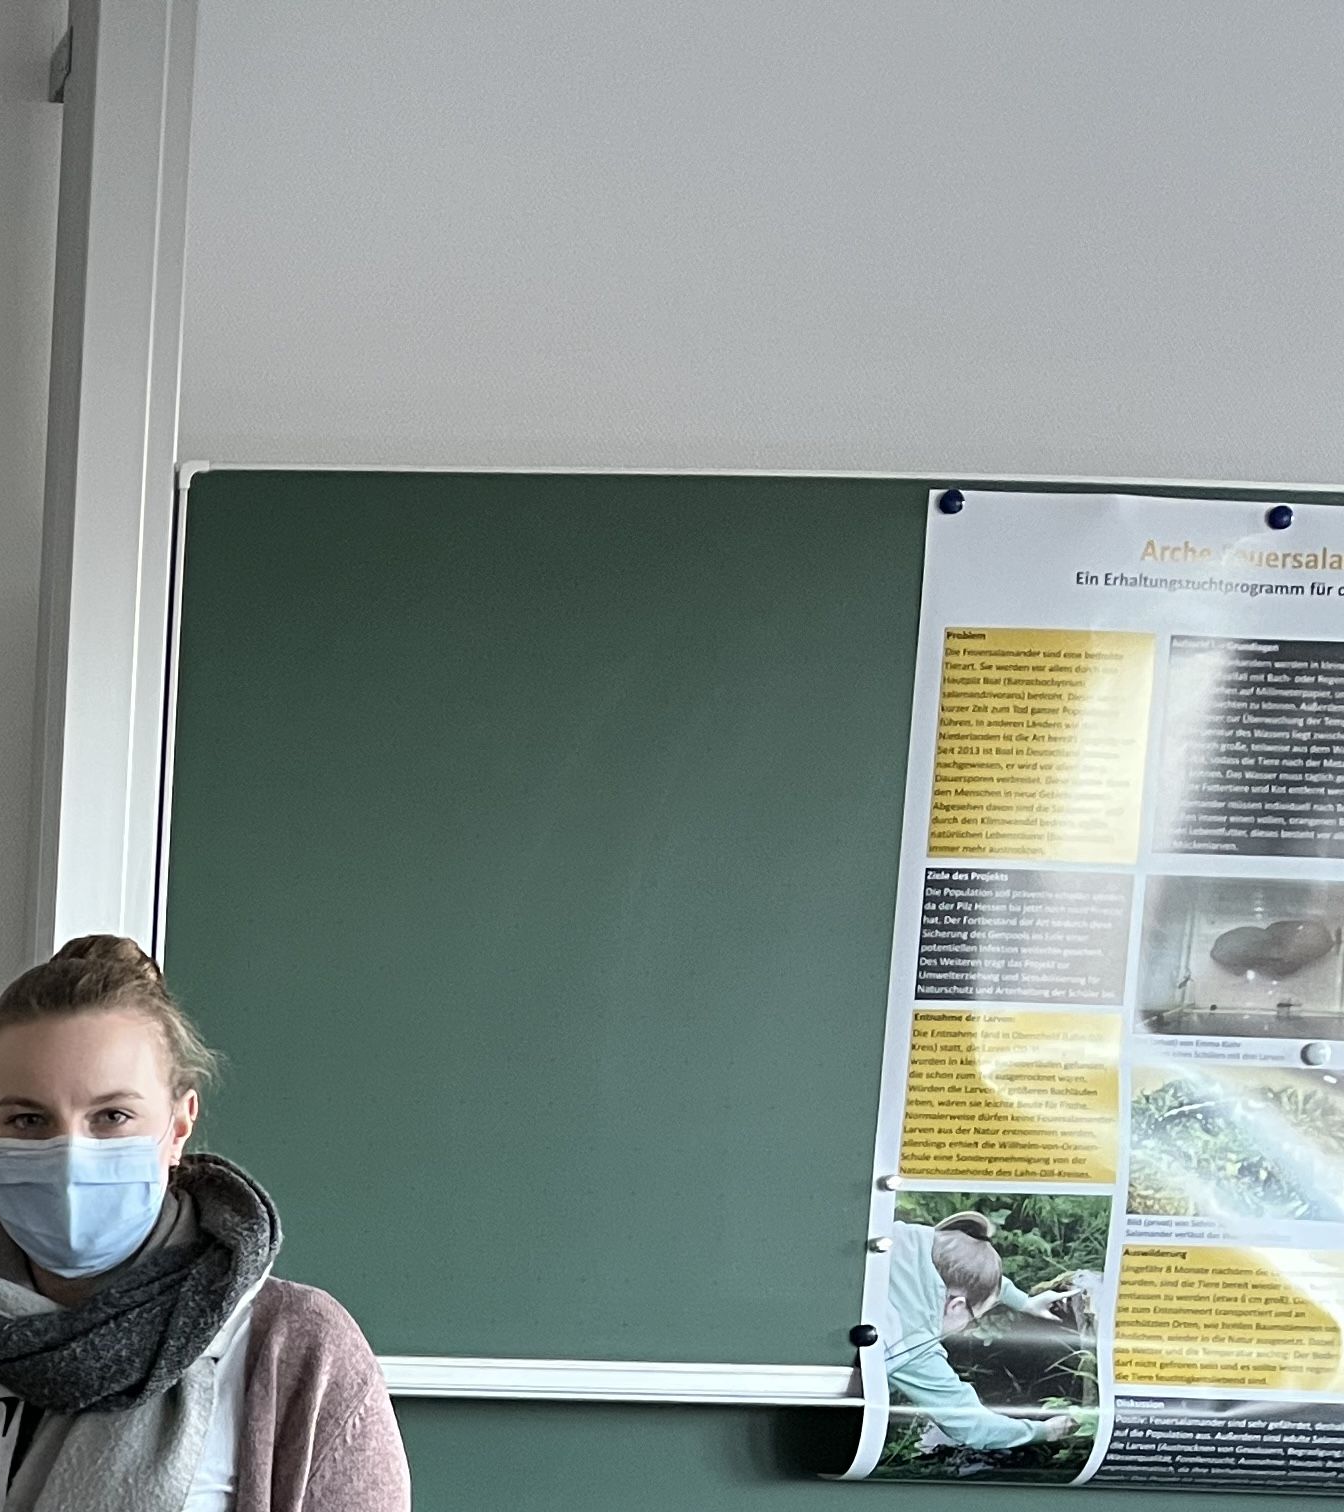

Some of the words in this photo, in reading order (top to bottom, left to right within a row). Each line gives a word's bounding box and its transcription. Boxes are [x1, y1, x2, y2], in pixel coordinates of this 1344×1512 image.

[1141, 539, 1211, 563] Arche
[1222, 543, 1344, 571] uersala
[1075, 571, 1099, 586] Ein
[1104, 572, 1306, 597] Erhaltungszuchtprogramm
[1310, 581, 1334, 596] für
[946, 630, 986, 641] Problem
[957, 745, 980, 754] 2013
[926, 870, 950, 879] Ziele
[951, 871, 969, 879] des
[970, 872, 1008, 882] Projekts
[925, 887, 941, 895] Die
[943, 887, 992, 898] Population
[924, 901, 936, 909] da
[938, 901, 954, 909] der
[956, 902, 972, 910] Pilz
[943, 915, 961, 923] Der
[921, 929, 968, 939] Sicherung
[917, 984, 973, 994] Naturschutz
